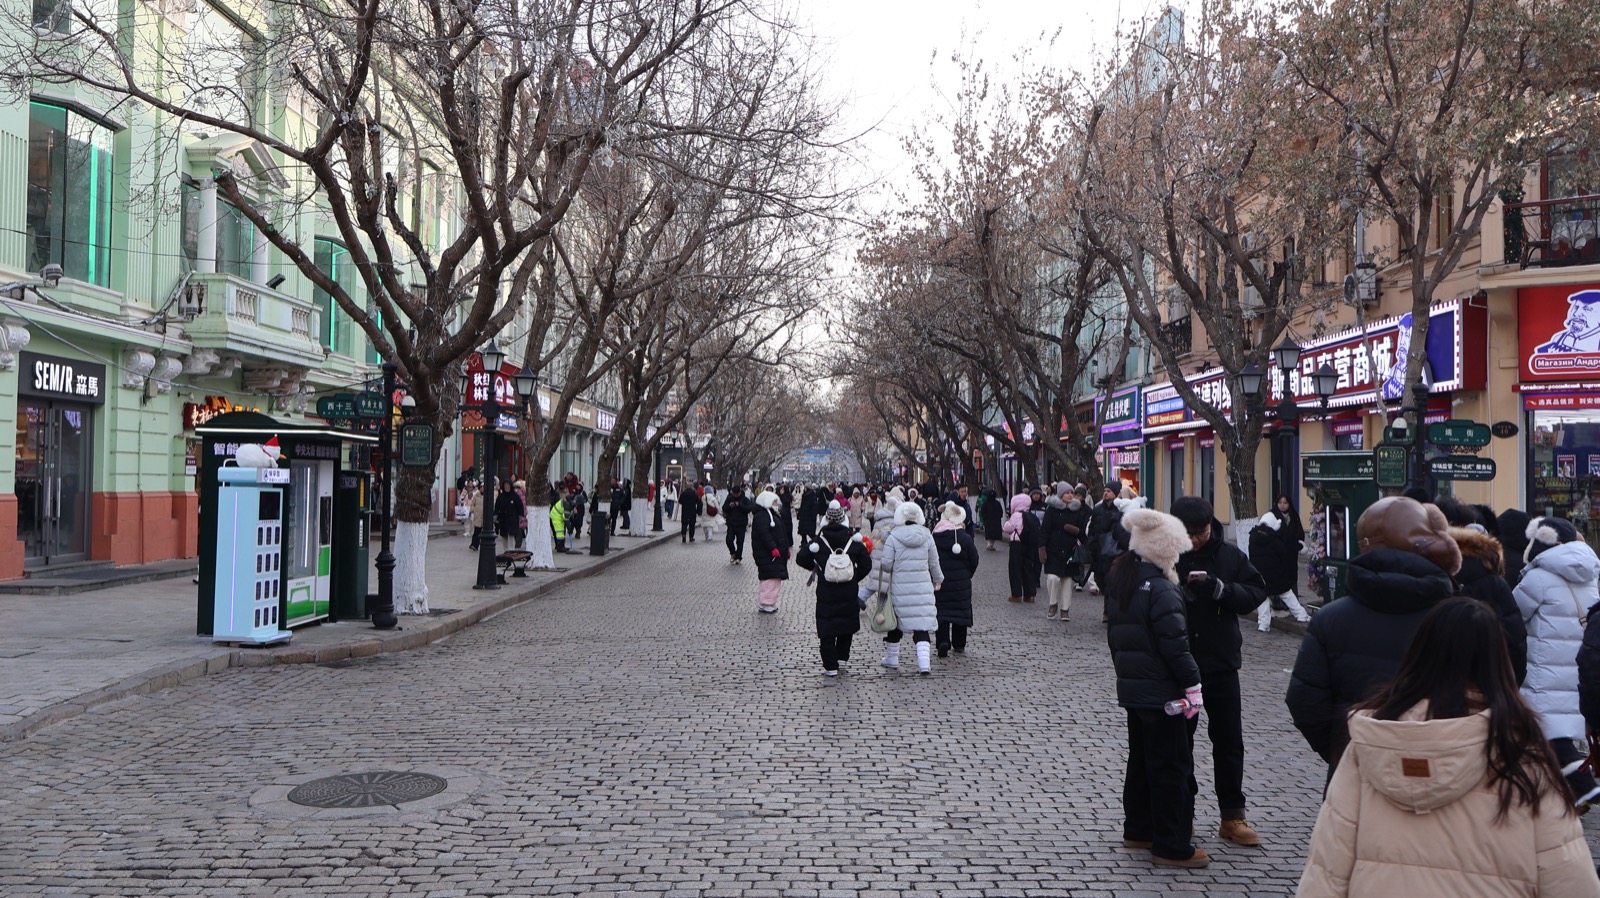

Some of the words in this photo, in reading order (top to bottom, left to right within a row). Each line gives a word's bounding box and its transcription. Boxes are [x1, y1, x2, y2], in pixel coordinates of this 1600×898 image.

[1537, 359, 1573, 367] Магазин
[361, 399, 383, 410] 中央大街
